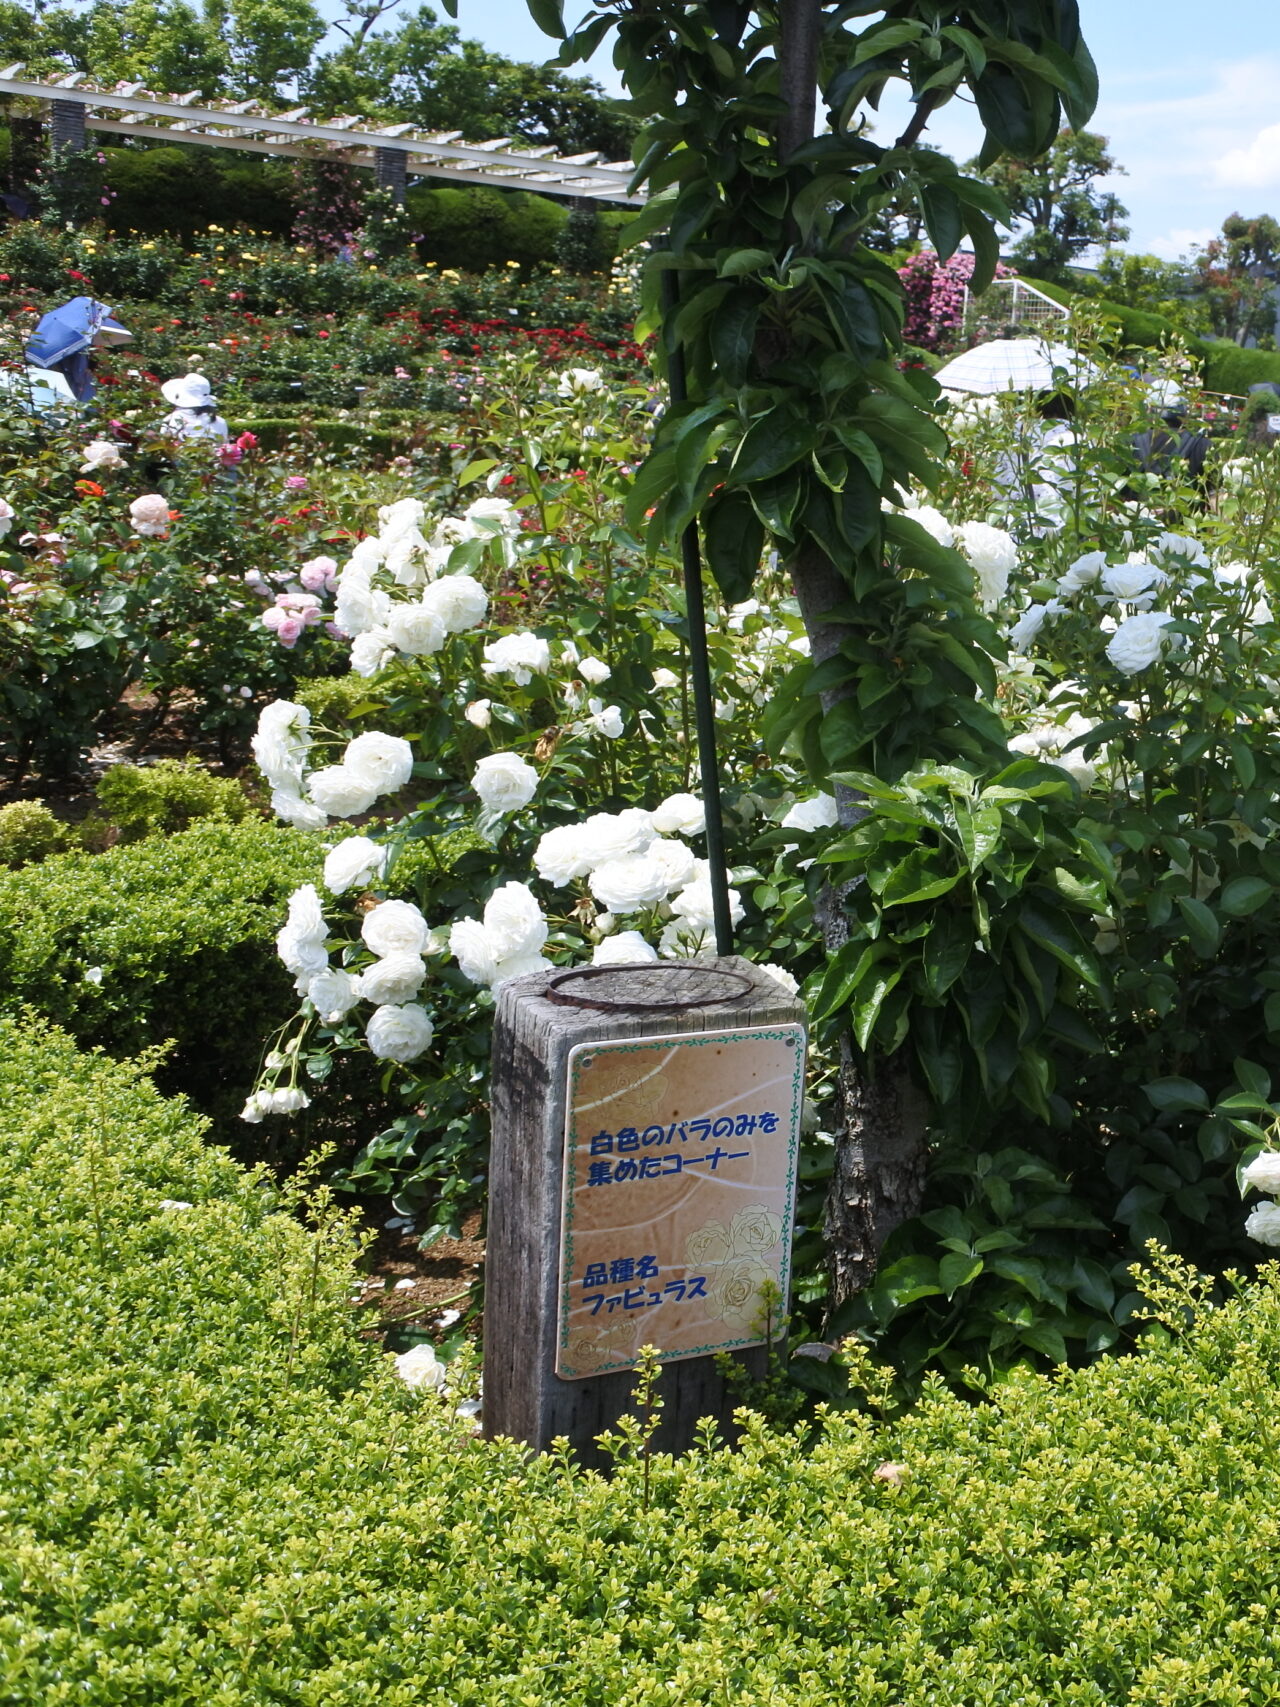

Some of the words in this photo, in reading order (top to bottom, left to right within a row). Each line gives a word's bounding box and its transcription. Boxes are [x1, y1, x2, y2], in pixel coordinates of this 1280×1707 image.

[589, 1111, 780, 1156] 白色のバラのみを
[587, 1148, 750, 1187] 集めたコーナー
[582, 1255, 660, 1289] 品種名
[582, 1277, 708, 1316] ファビュラス
